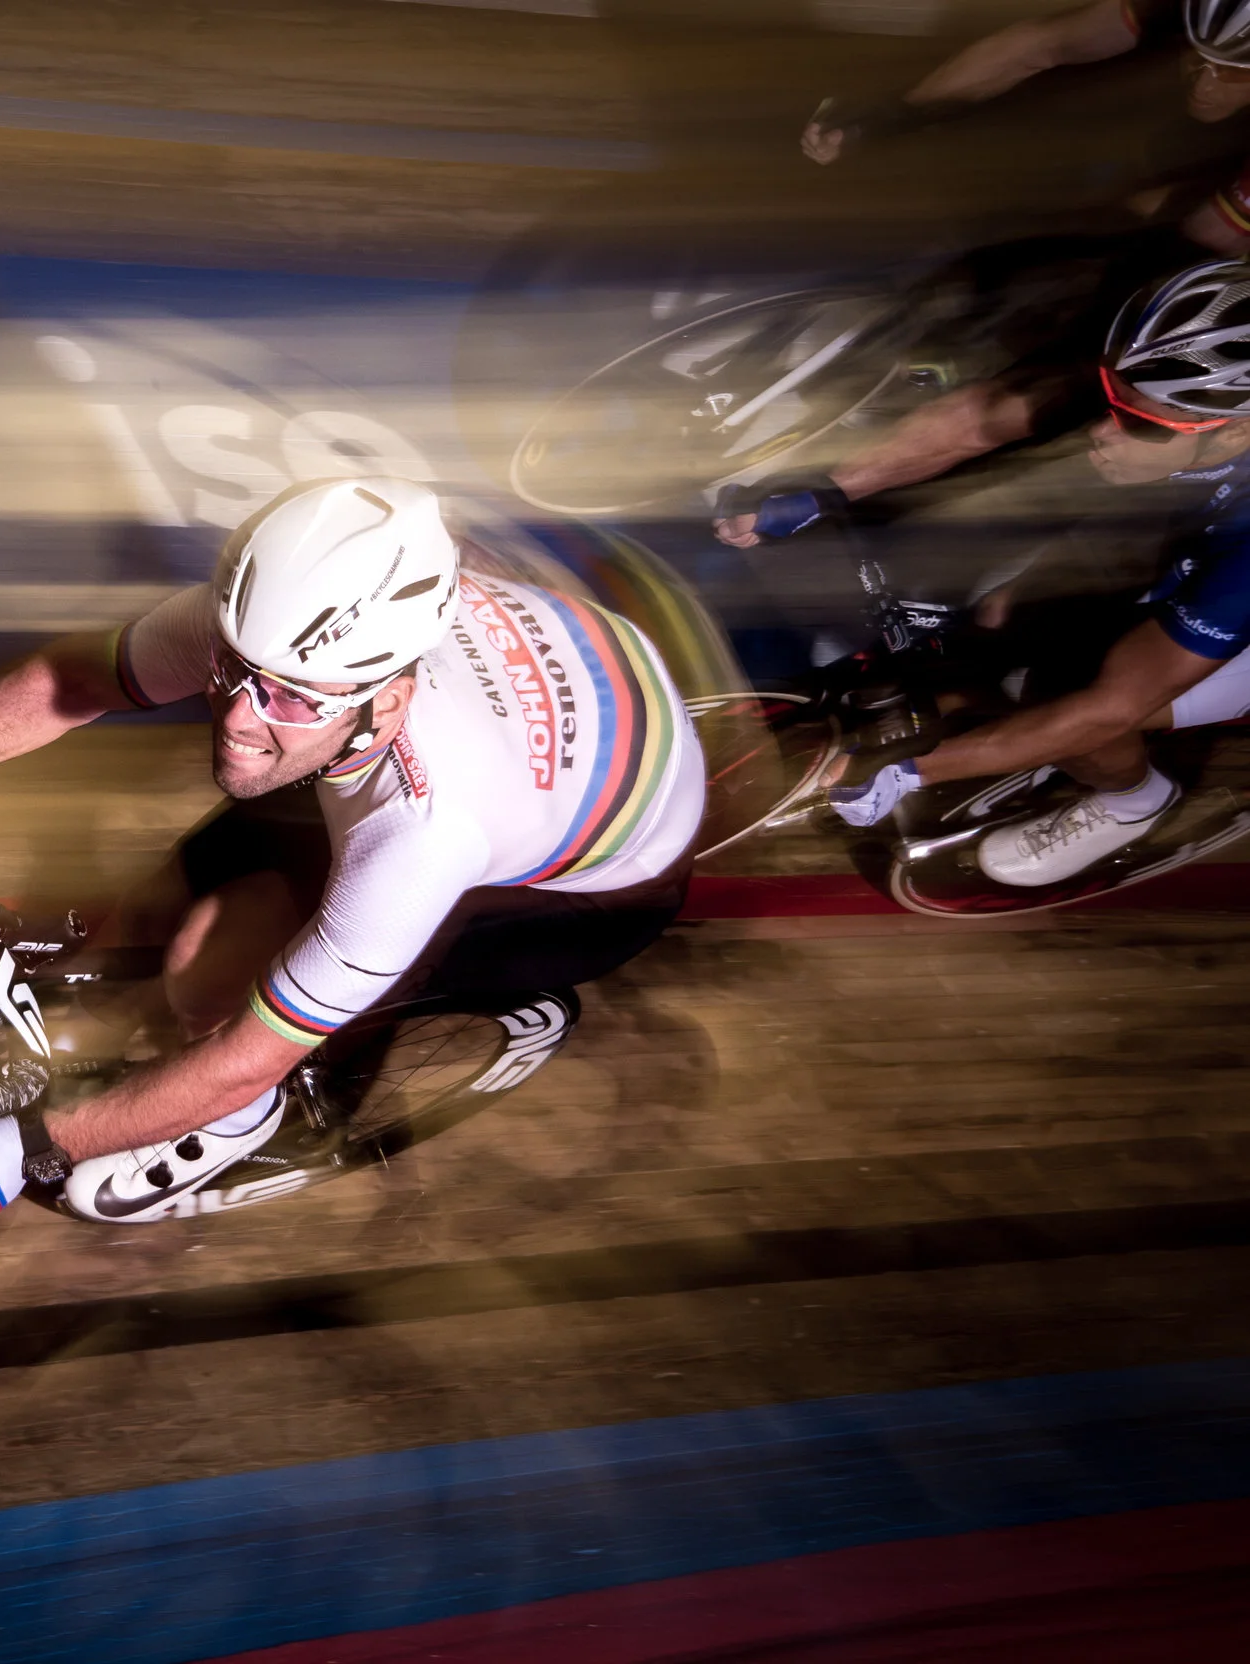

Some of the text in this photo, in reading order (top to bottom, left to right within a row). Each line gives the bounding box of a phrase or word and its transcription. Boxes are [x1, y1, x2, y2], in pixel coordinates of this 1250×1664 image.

[297, 598, 361, 664] MET
[451, 616, 508, 718] CAVENDI
[459, 582, 554, 790] JOHN SAE
[388, 750, 412, 799] novatie
[395, 727, 429, 797] OHN SAEY
[252, 1155, 289, 1164] DESIGN
